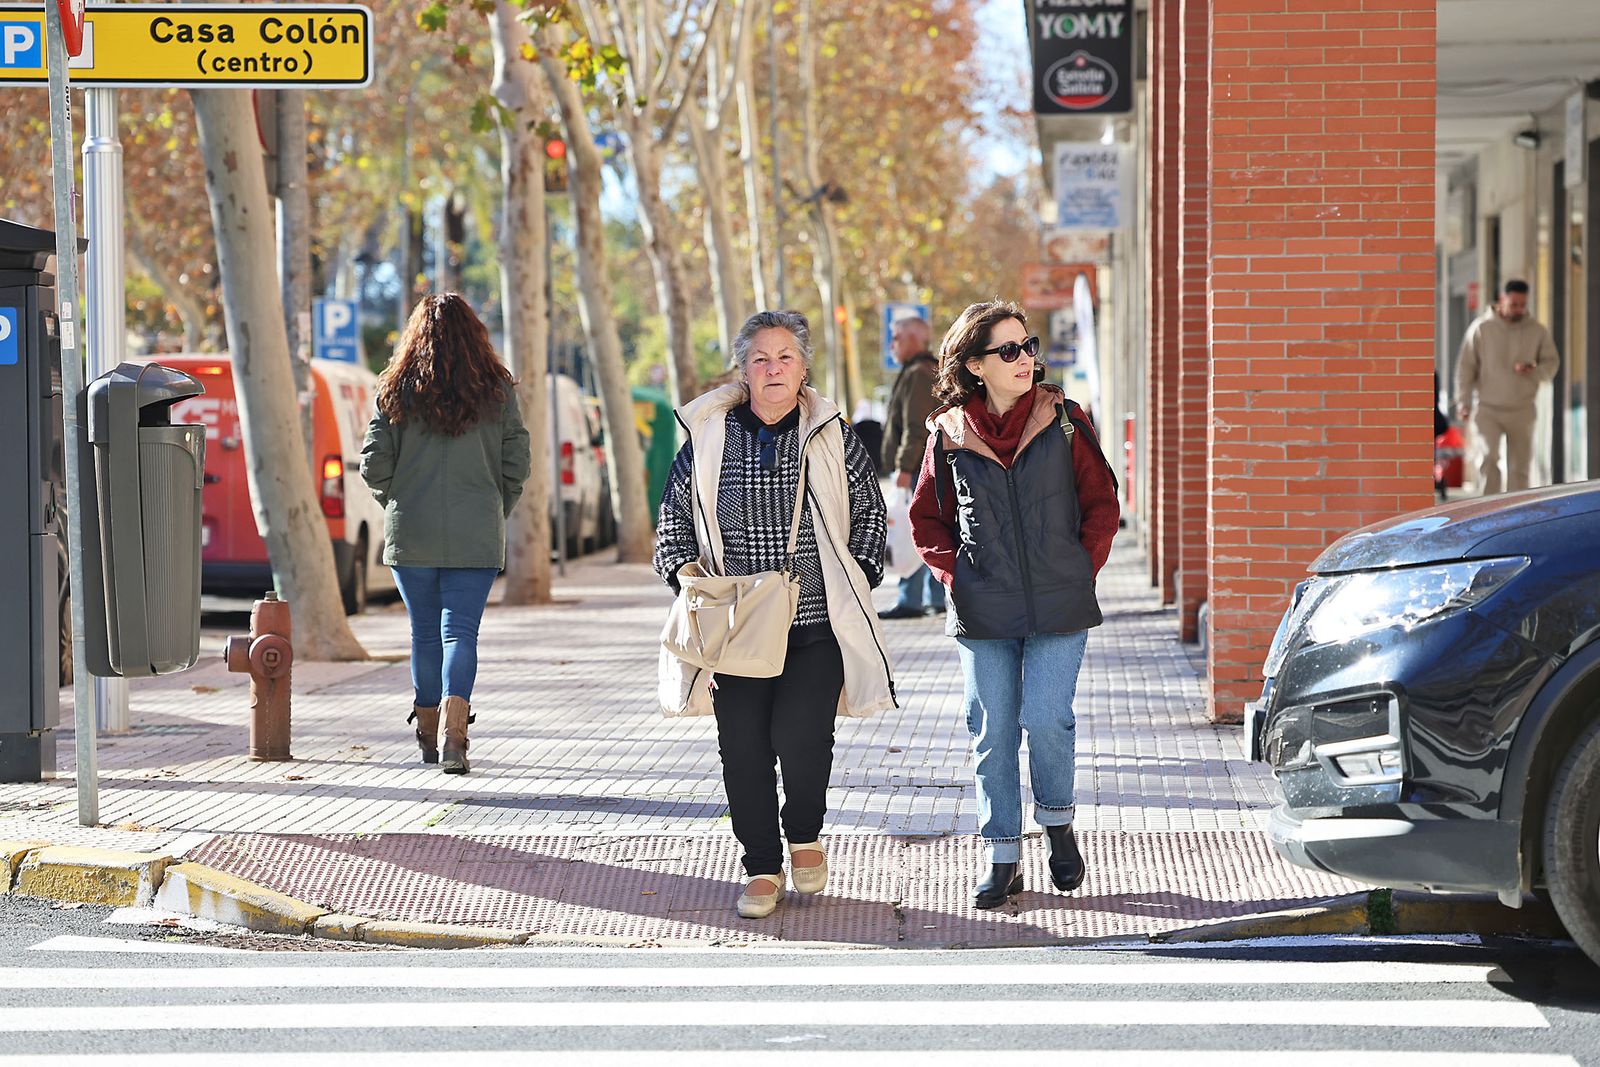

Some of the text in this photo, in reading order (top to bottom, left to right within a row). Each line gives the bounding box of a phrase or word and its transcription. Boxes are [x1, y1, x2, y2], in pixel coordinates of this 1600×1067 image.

[150, 17, 359, 44] Casa Colón
[1038, 12, 1124, 39] YOMY
[4, 26, 34, 64] P
[197, 49, 312, 75] (centro)
[324, 303, 351, 337] P
